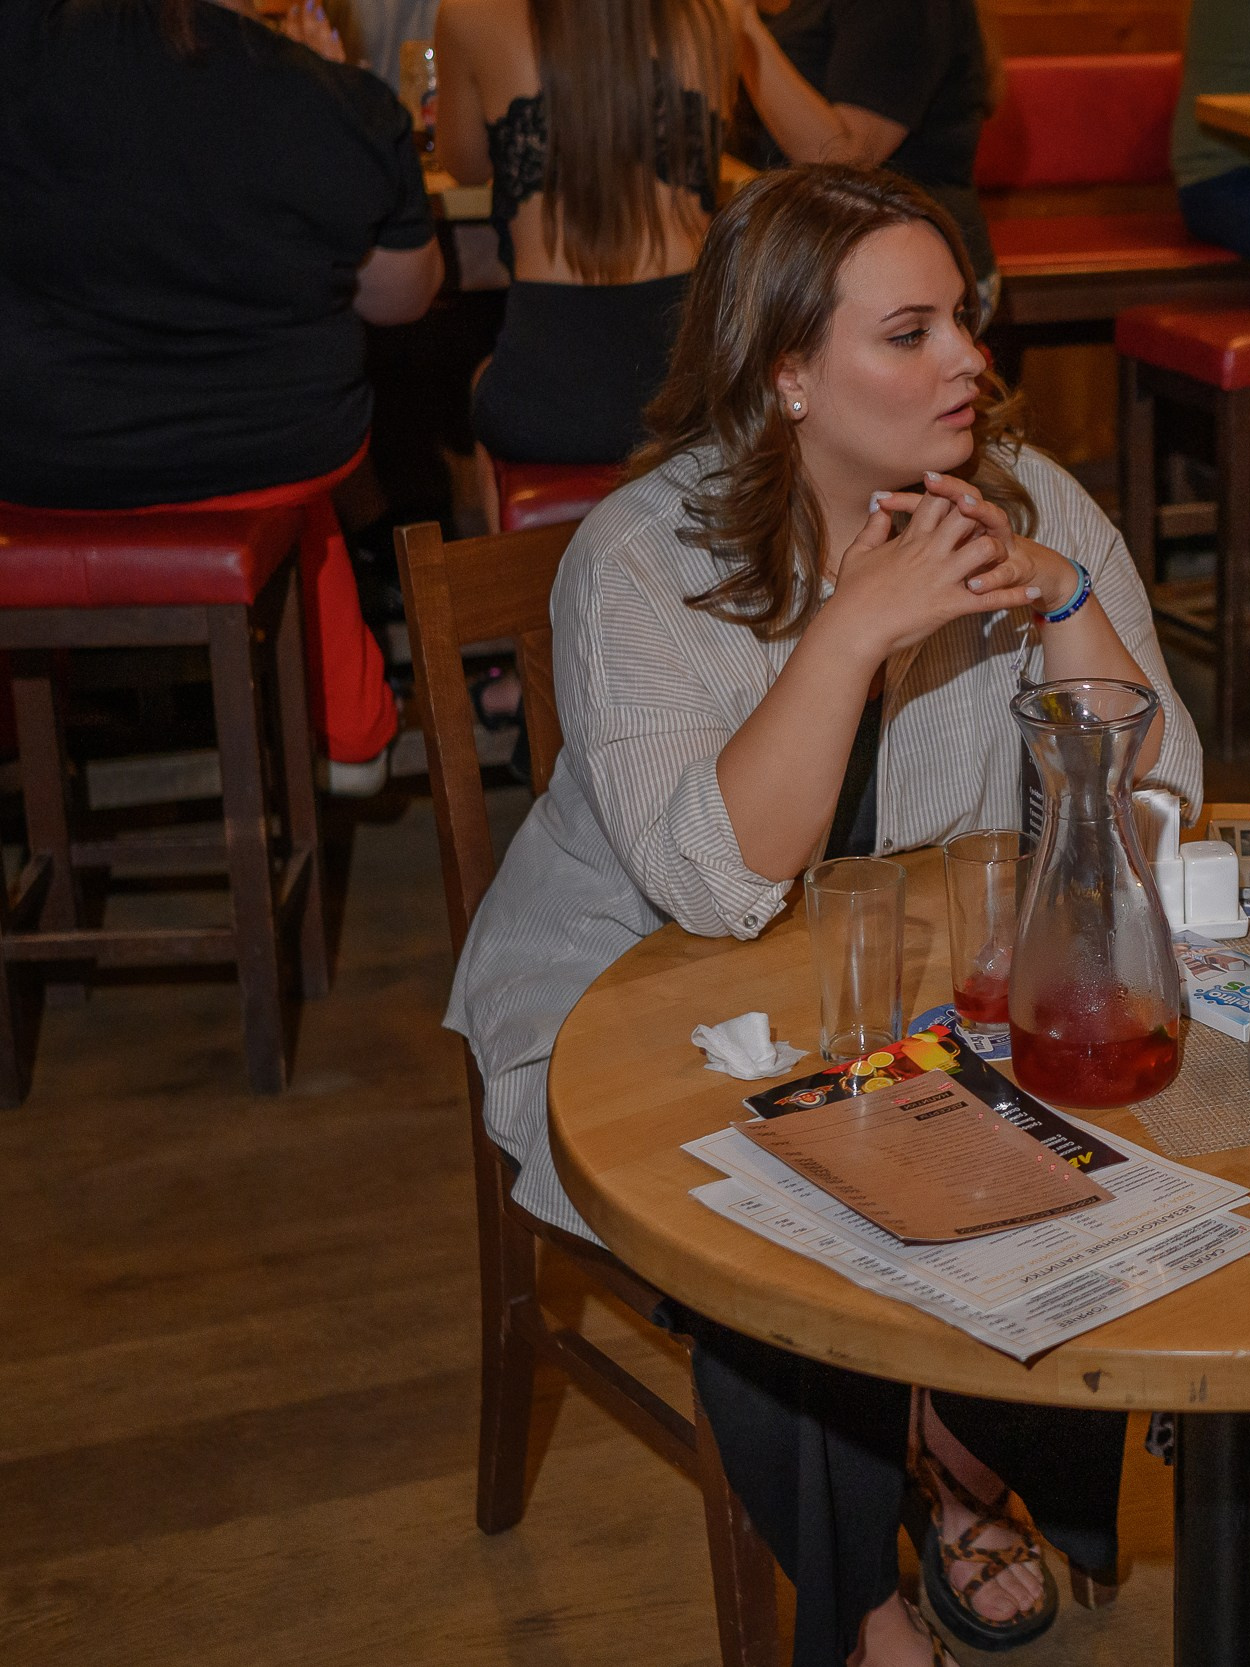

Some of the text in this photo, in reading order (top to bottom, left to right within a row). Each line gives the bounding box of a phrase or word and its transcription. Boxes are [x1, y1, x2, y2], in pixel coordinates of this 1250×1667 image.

[1084, 1203, 1196, 1255] БЕЗАЛКОГОЛЬНЫЕ
[1019, 1252, 1084, 1284] НАПИТКИ
[1179, 1247, 1225, 1272] САЛАТЫ
[1056, 1303, 1107, 1328] ГОРЯЧЕЕ
